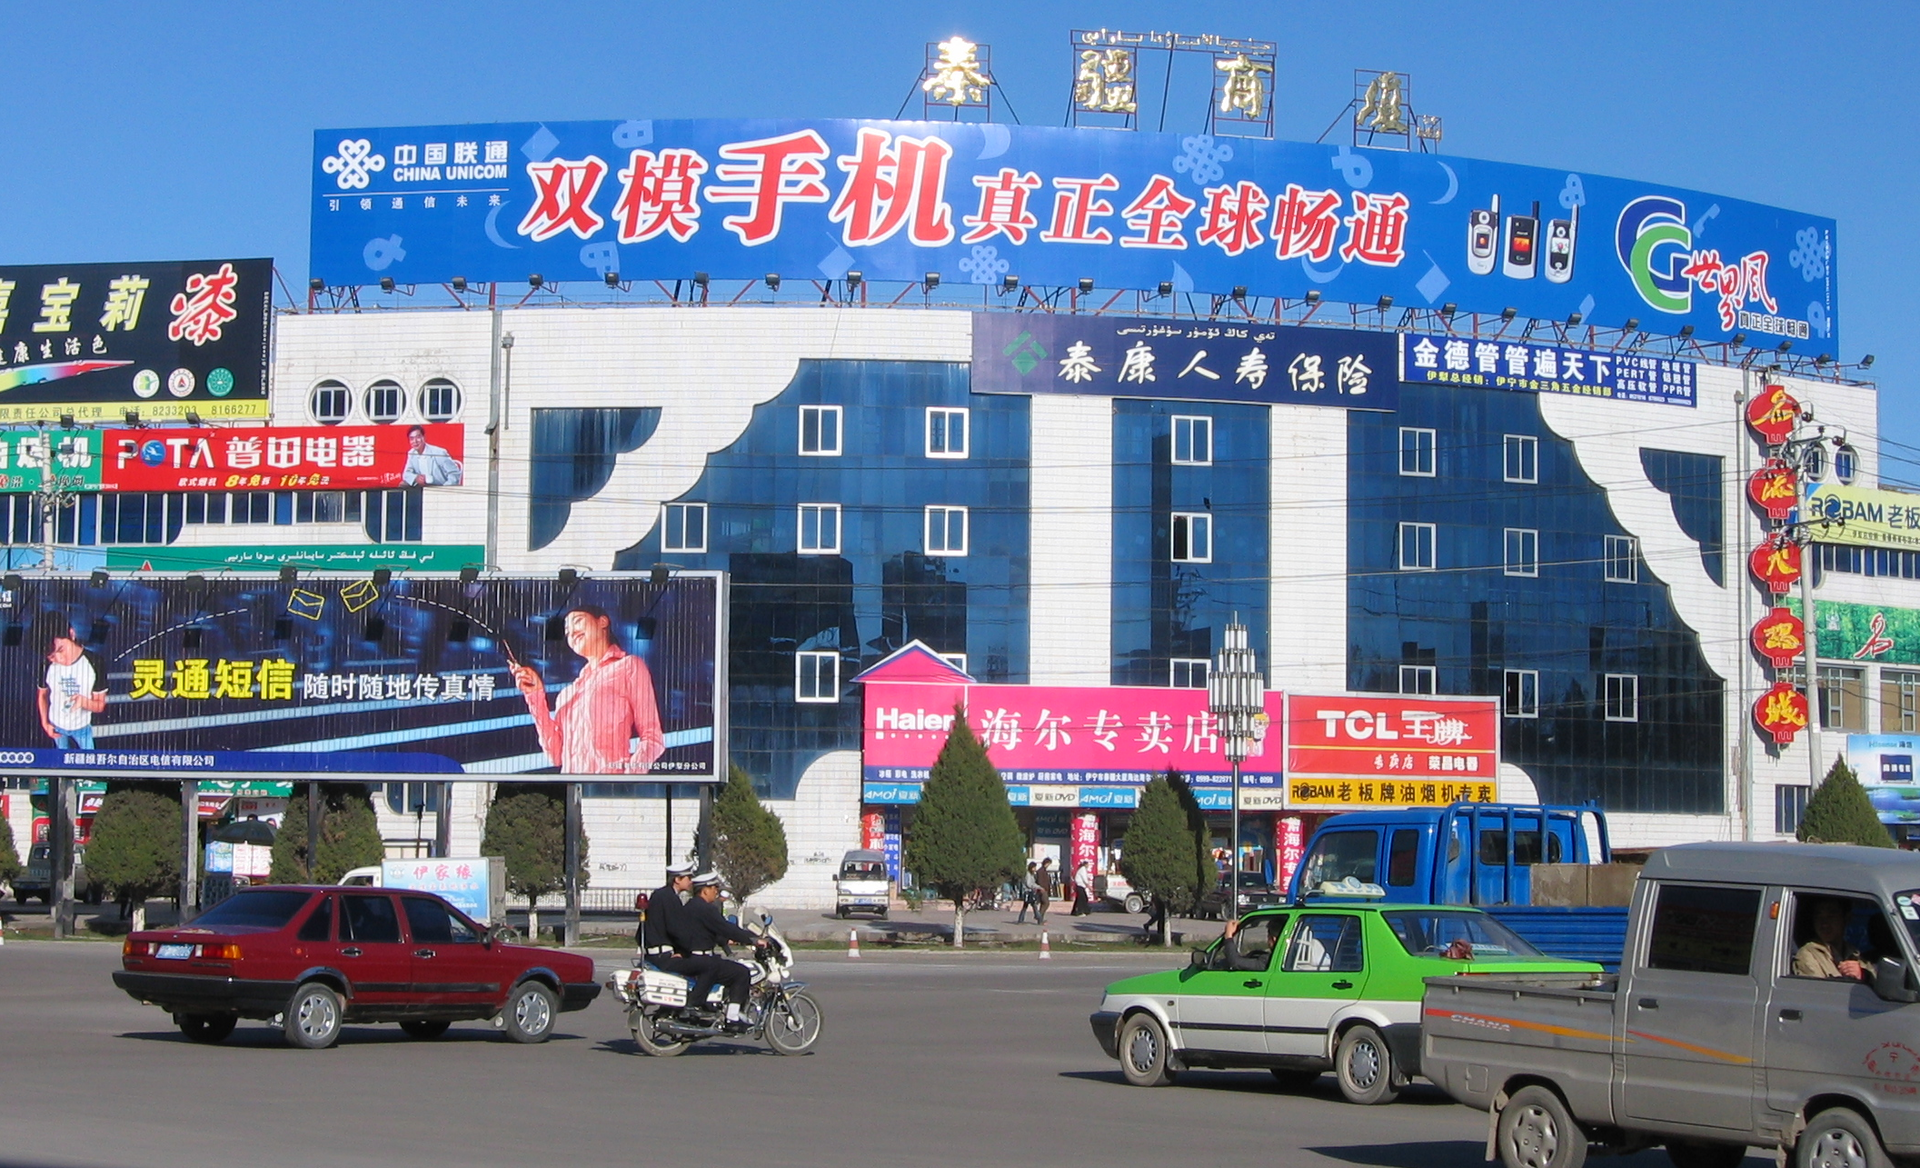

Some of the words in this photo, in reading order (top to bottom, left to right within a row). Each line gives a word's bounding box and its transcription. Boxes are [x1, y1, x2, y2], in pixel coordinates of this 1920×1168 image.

[394, 140, 509, 166] 中国联通
[393, 167, 441, 182] CHINA
[446, 164, 508, 180] UNICOM
[329, 194, 501, 212] 引领通信未来
[517, 127, 954, 247] 双模手机
[961, 168, 1409, 267] 真正全球畅通
[168, 263, 238, 346] 漆
[1682, 250, 1778, 331] 世界风
[1738, 311, 1810, 340] 真正全球畅通
[1058, 340, 1372, 394] 泰康人寿保险
[1413, 337, 1613, 384] 金德管管遍天下
[1616, 367, 1645, 380] PERT
[1662, 384, 1691, 397] PPR管
[152, 405, 198, 417] 8233203
[211, 404, 257, 416] 8166277
[0, 436, 92, 469] 烟机
[225, 435, 376, 469] 普田电器
[129, 658, 297, 700] 灵通短信
[303, 673, 496, 701] 随时随地传真情
[875, 707, 956, 731] Haier
[980, 708, 1218, 754] 海尔专卖店
[1316, 710, 1399, 740] TCL
[1401, 710, 1473, 746] 王牌
[63, 752, 216, 767] 新疆维吾尔自治区电信有限公司
[1374, 753, 1414, 770] 专卖店
[1428, 755, 1479, 772] 荣昌电器
[1292, 782, 1335, 801] ROBAM
[1337, 782, 1492, 803] 老板牌油烟机专卖
